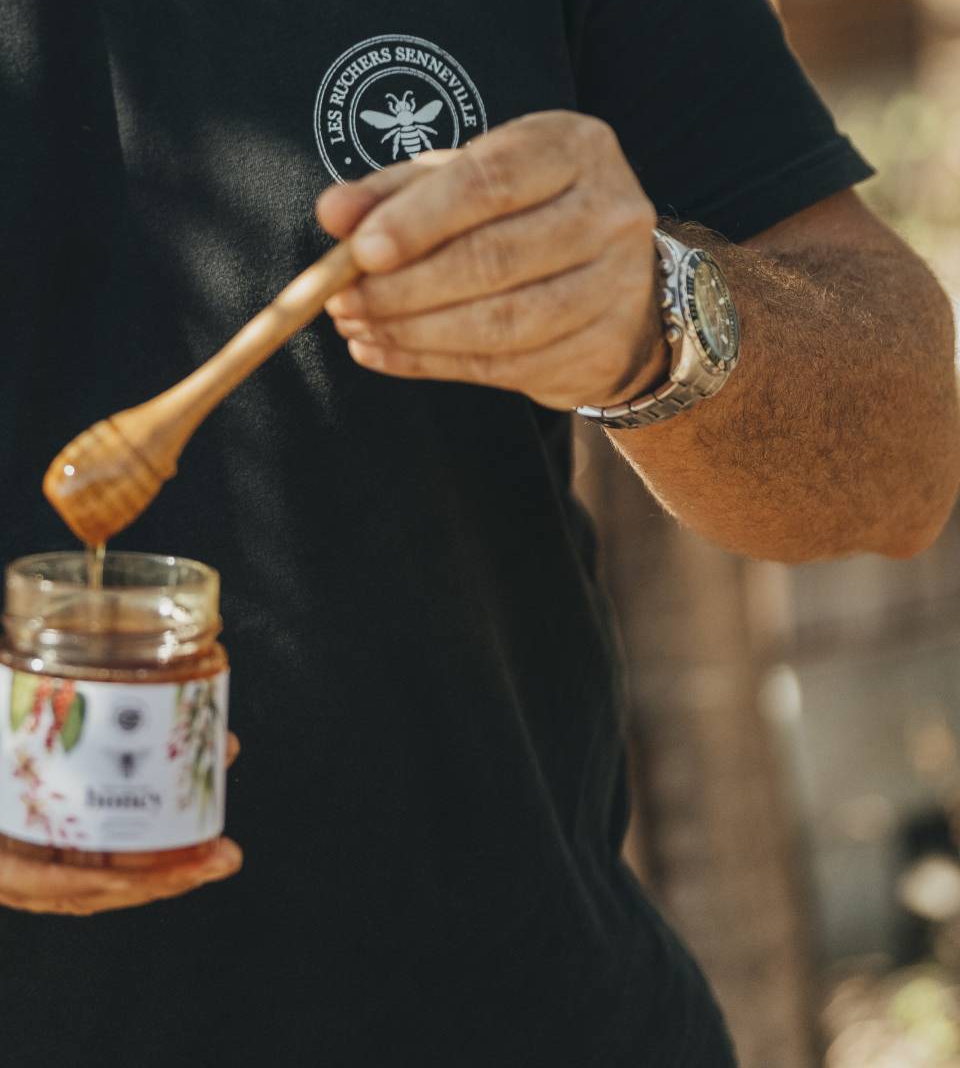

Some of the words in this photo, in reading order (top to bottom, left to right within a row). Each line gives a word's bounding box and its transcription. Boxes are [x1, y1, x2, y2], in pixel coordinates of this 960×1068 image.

[330, 47, 392, 107] RUCHERS
[395, 47, 477, 127] SENNEVILLE
[328, 110, 345, 145] LES
